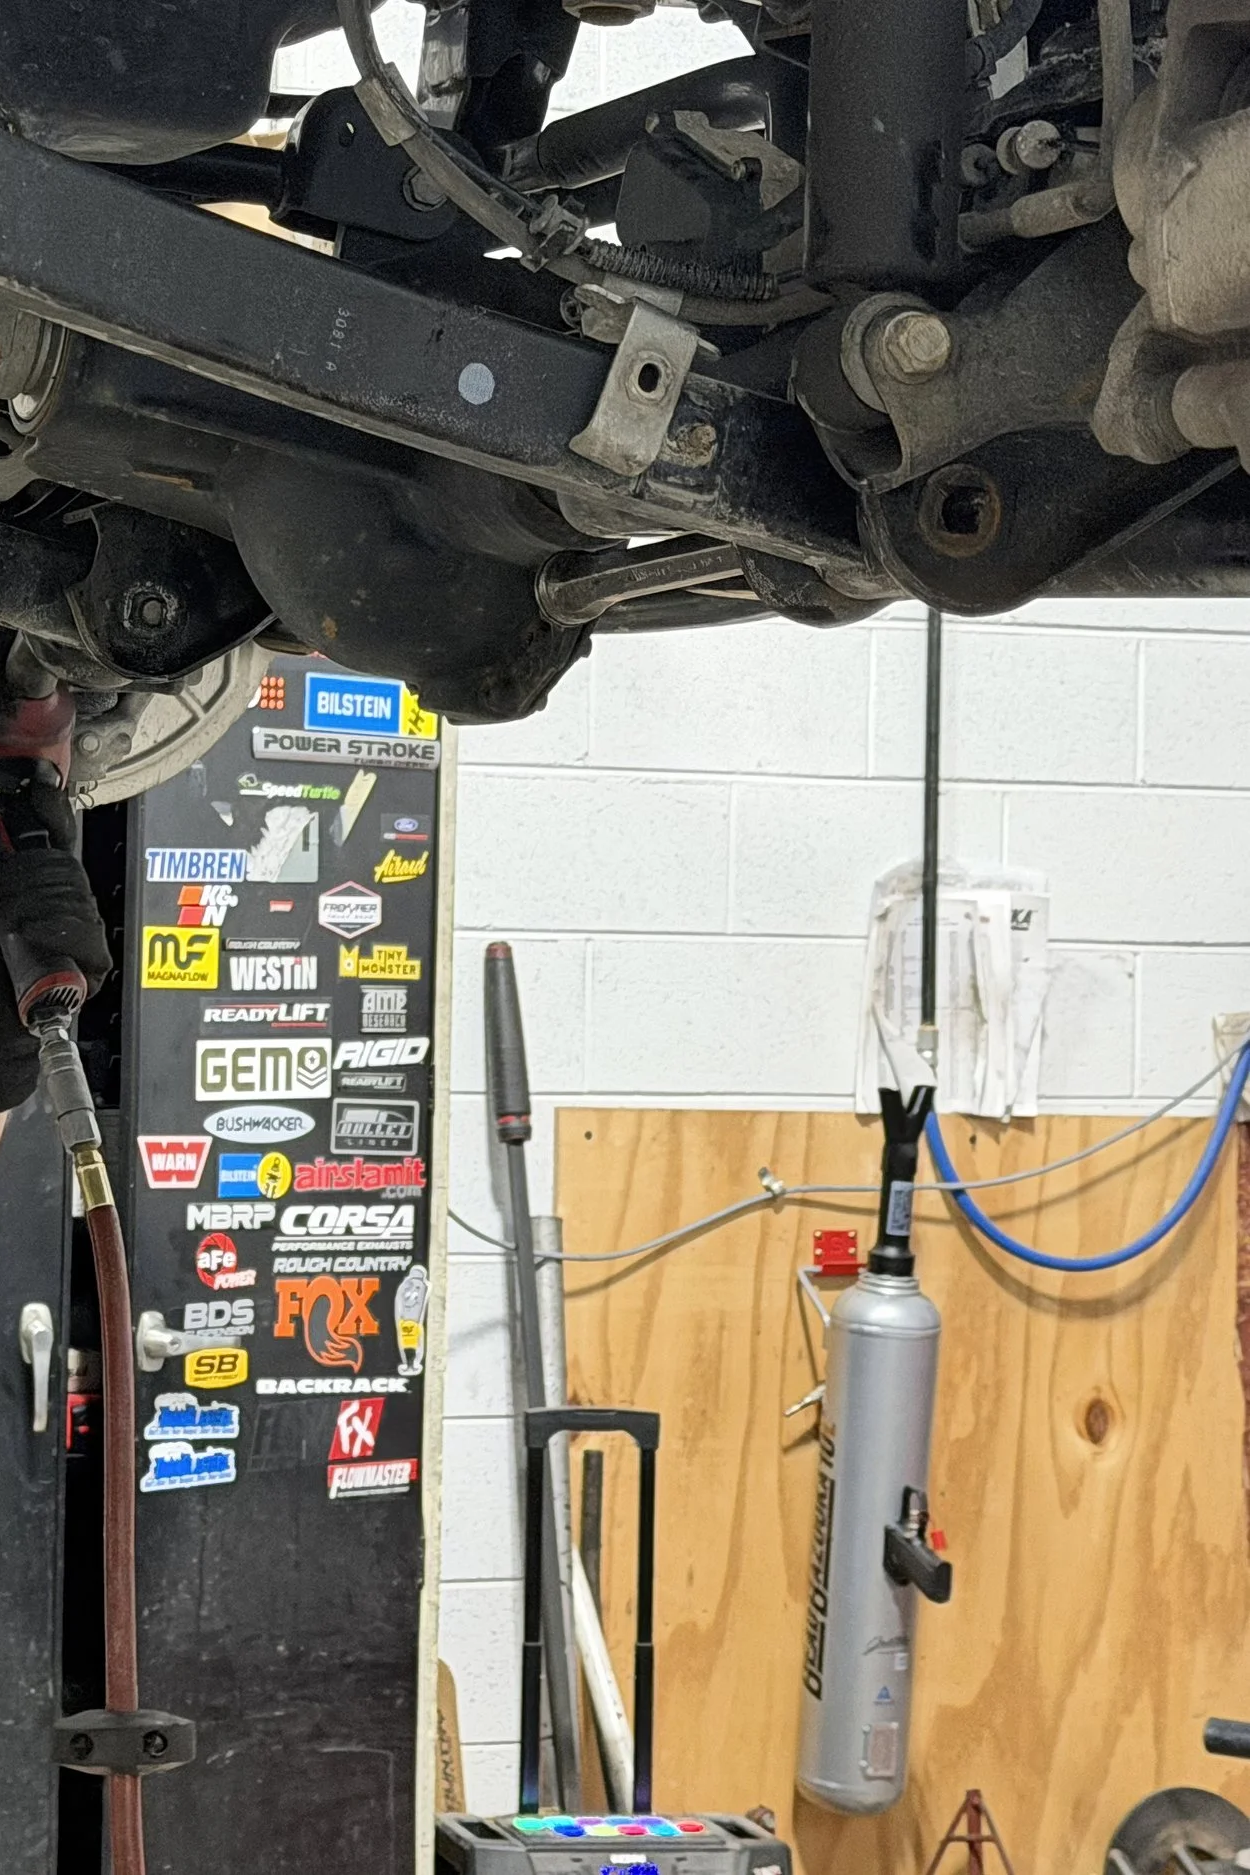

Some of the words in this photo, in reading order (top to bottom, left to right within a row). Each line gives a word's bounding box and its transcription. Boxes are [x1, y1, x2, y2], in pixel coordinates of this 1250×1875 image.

[316, 691, 392, 720] BILSTEIN
[263, 733, 341, 754] POWER
[347, 738, 436, 760] STROKE
[148, 851, 244, 879] TIMBREN
[377, 950, 403, 960] TINY
[147, 971, 209, 982] MAGNAFLOW
[361, 963, 417, 975] MONSTER
[203, 1003, 330, 1022] READYLIFT
[332, 1036, 430, 1070] RIGID
[215, 1116, 304, 1132] BUSHWACKER
[151, 1152, 198, 1171] WARN
[294, 1156, 426, 1193] airslamit
[186, 1202, 276, 1231] MBRP
[279, 1204, 415, 1236] CORSA
[197, 1249, 237, 1271] aFe
[273, 1257, 333, 1274] ROUGH
[333, 1255, 413, 1273] COUNTRY
[183, 1299, 255, 1330] BDS
[273, 1276, 381, 1338] FOX
[193, 1353, 240, 1375] SB
[255, 1377, 410, 1395] BACKRACK
[337, 1400, 376, 1458] FX
[329, 1461, 412, 1499] FLOWMASTER
